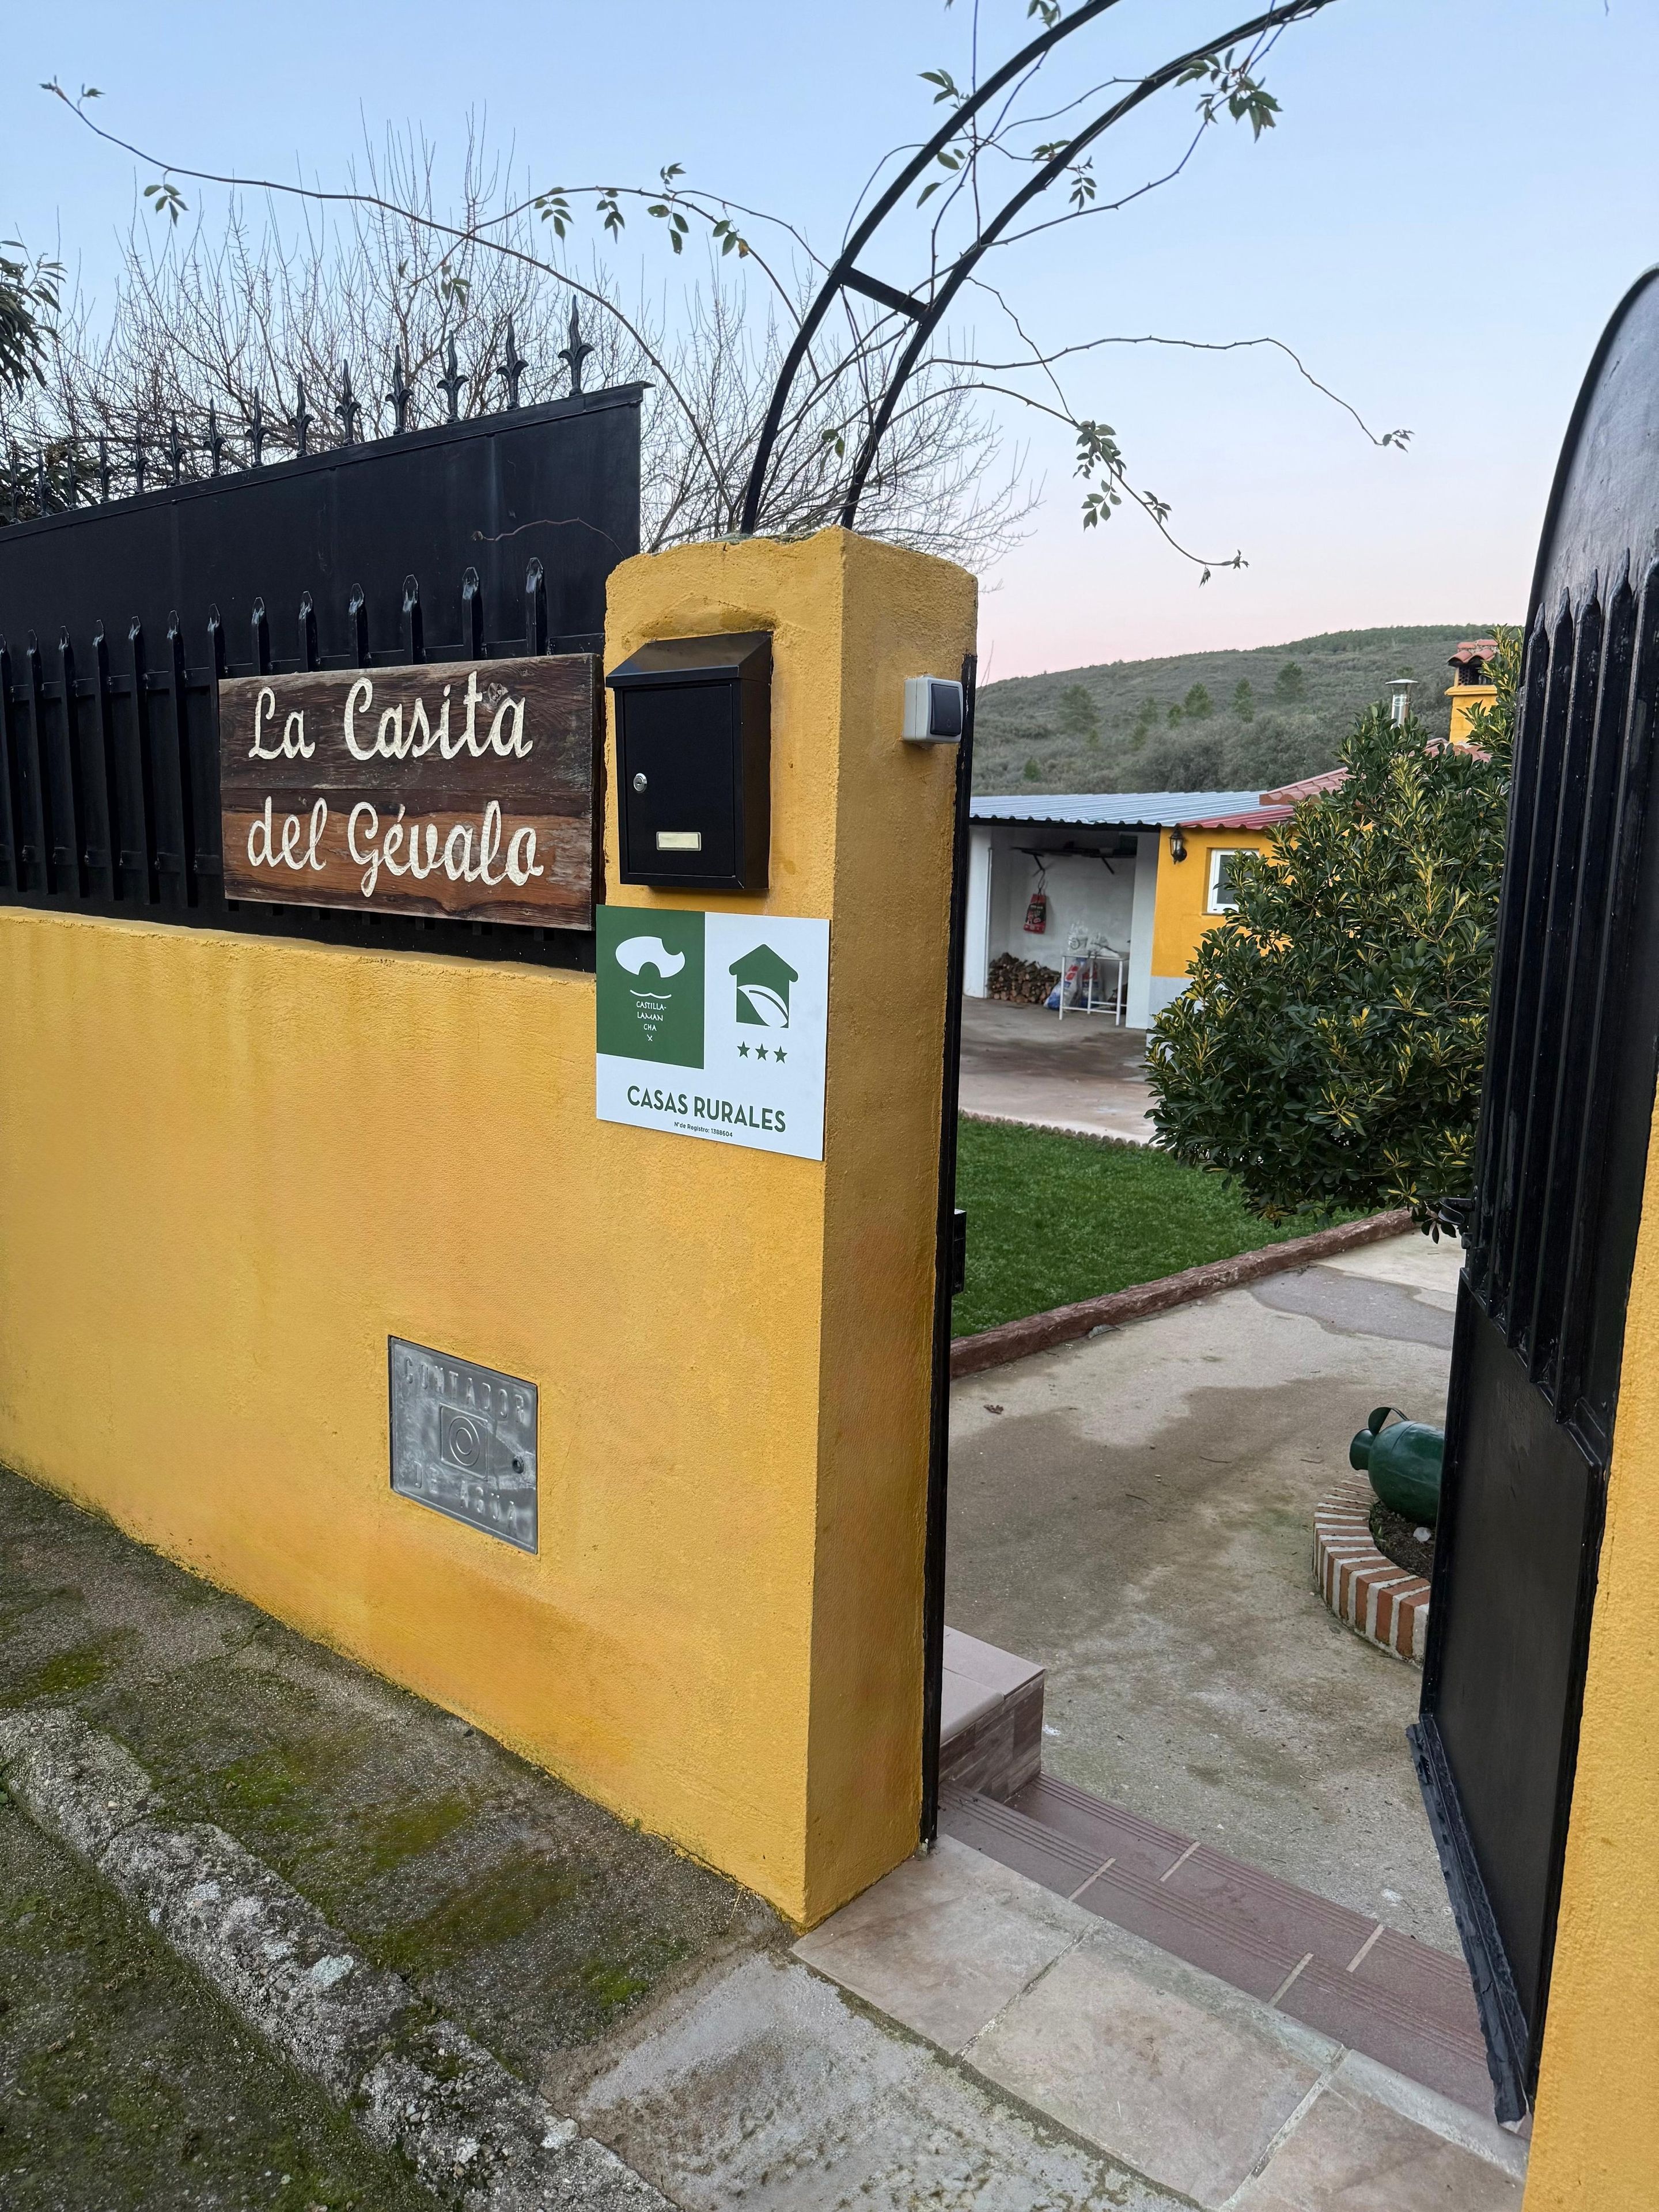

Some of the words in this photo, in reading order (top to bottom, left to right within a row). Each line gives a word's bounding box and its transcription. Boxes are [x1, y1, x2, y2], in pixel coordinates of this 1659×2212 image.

[248, 686, 315, 759] La
[344, 671, 533, 760] Casita
[247, 796, 327, 871] del
[347, 800, 544, 897] Gévalo
[637, 1012, 663, 1021] LAMAN
[627, 1085, 688, 1115] CASAS
[694, 1096, 786, 1132] RURALES
[687, 1124, 710, 1132] Registro:
[711, 1128, 733, 1137] 1388604
[404, 1356, 525, 1424] CONTADOR
[413, 1460, 438, 1494] DE
[460, 1480, 518, 1529] AGUA
